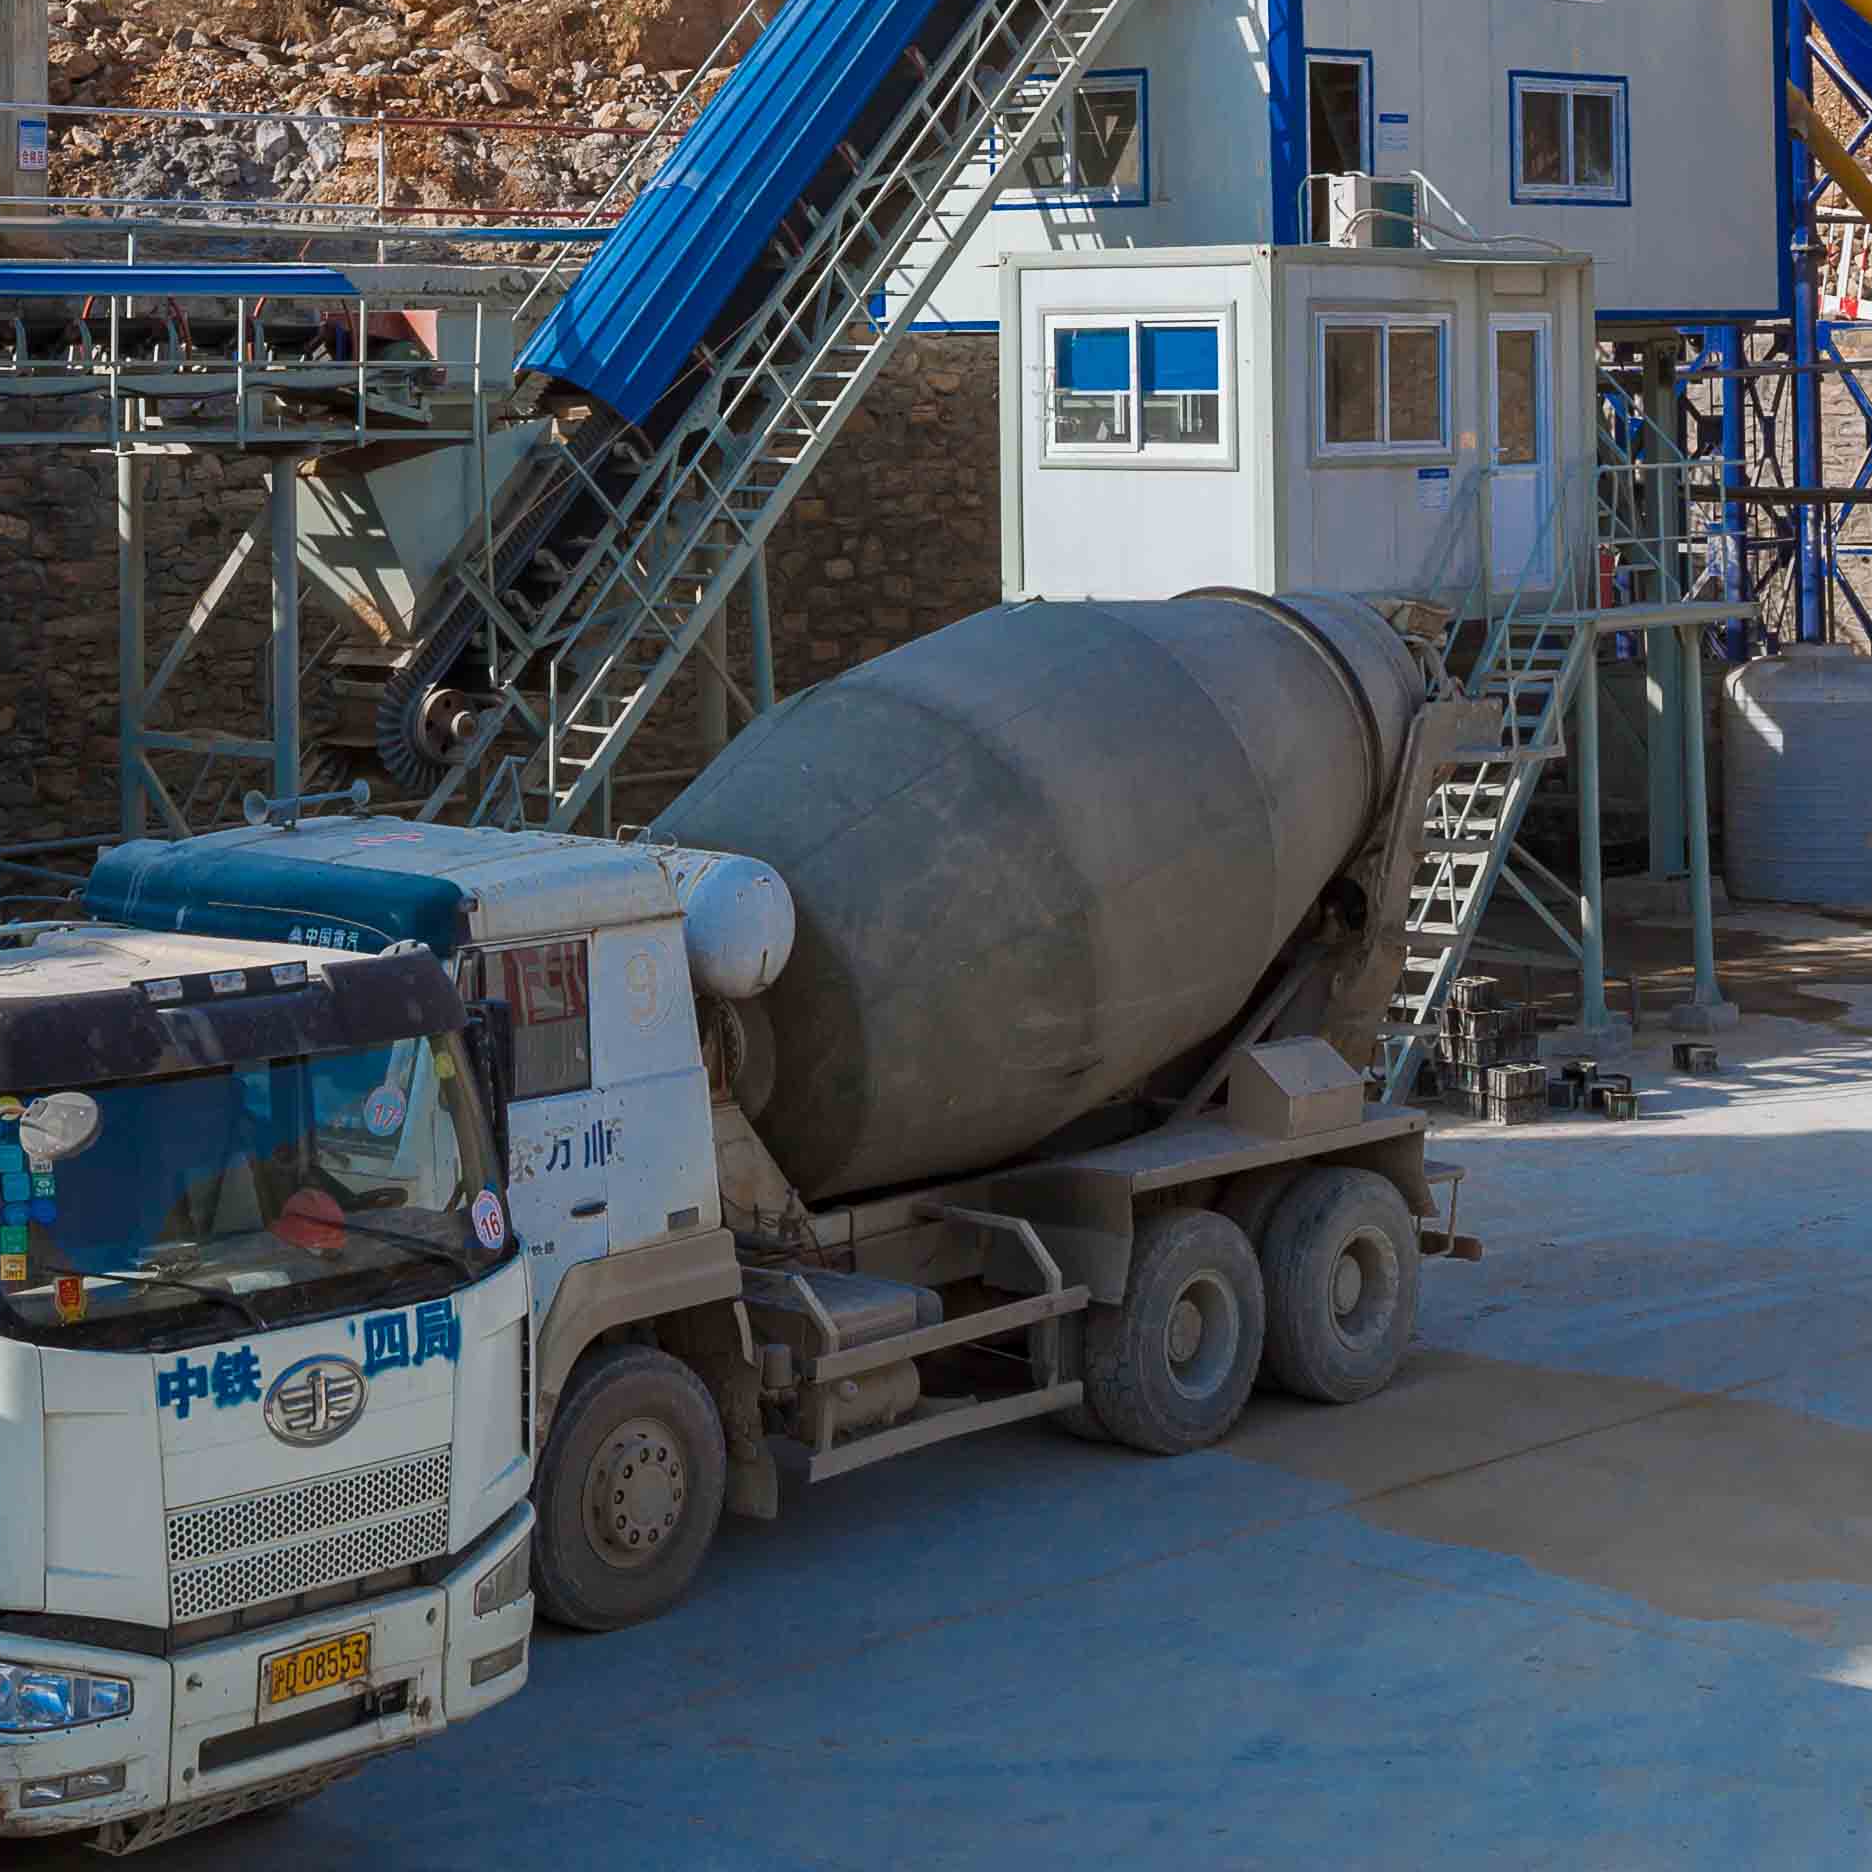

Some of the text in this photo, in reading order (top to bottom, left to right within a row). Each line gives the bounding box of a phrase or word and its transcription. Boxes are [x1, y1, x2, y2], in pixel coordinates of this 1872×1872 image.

[480, 1210, 502, 1241] 16
[157, 1296, 462, 1420] 中铁 四局
